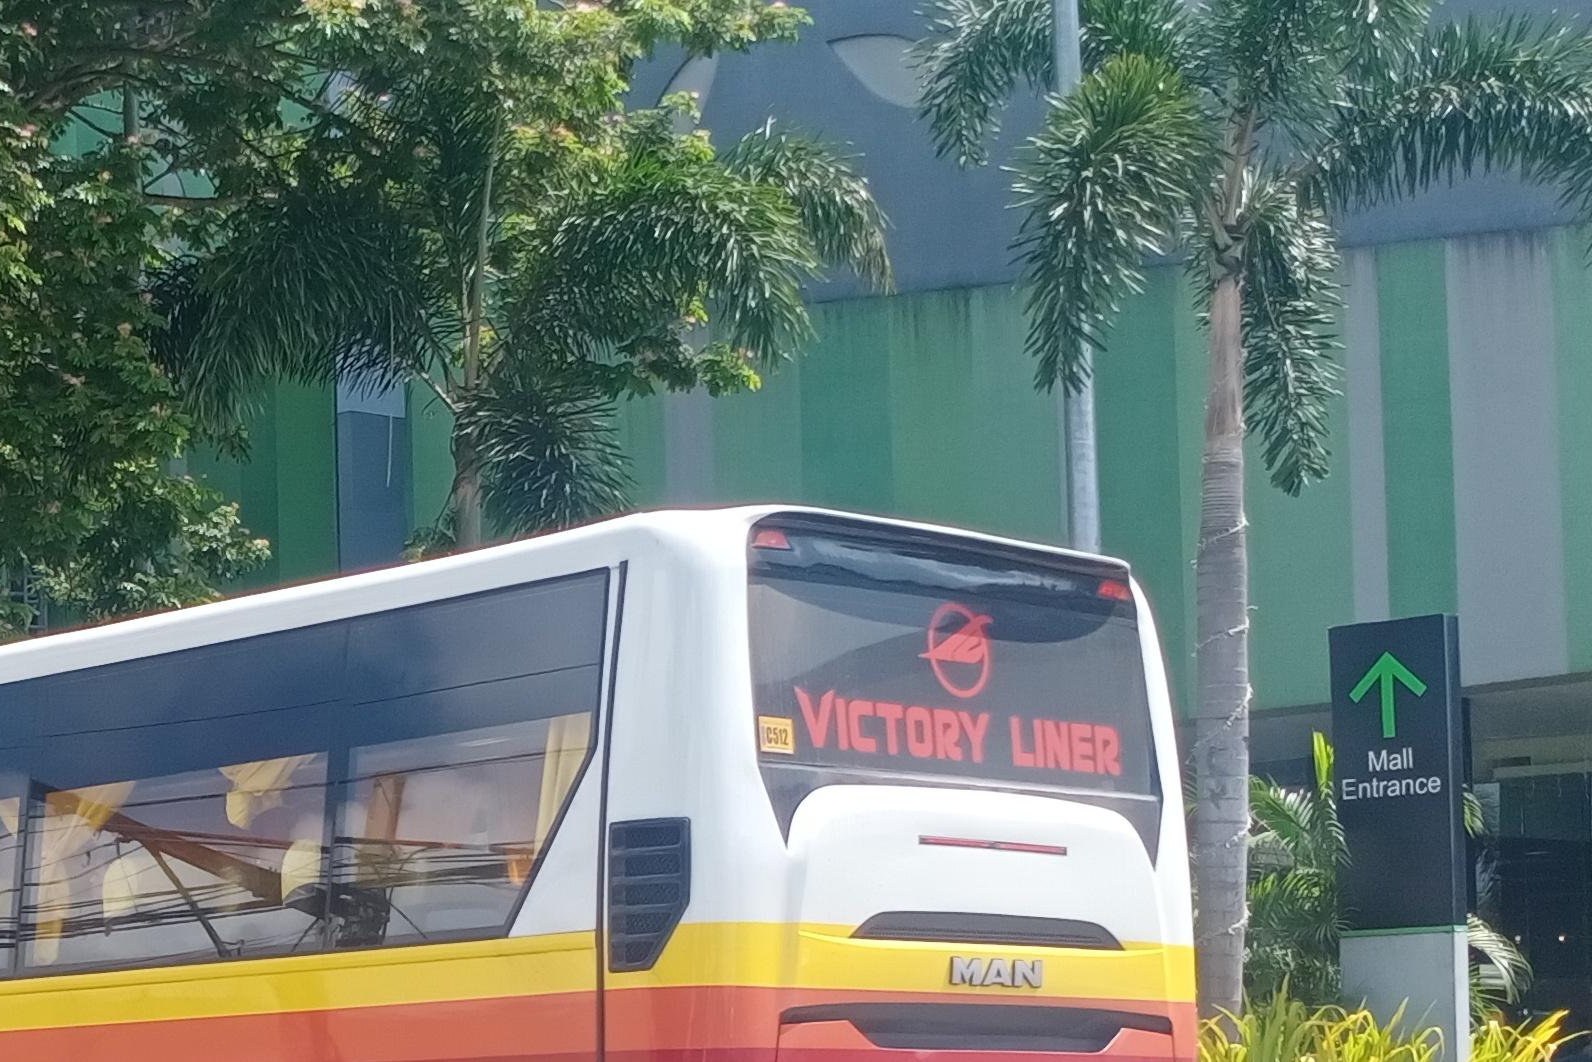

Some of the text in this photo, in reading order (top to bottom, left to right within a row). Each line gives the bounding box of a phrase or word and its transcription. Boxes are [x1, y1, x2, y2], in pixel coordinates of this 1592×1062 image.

[766, 726, 789, 745] C512
[794, 686, 1122, 776] VICTORY LINER
[1368, 747, 1414, 772] Mall
[1342, 776, 1441, 800] Entrance
[950, 955, 1042, 988] MAN
